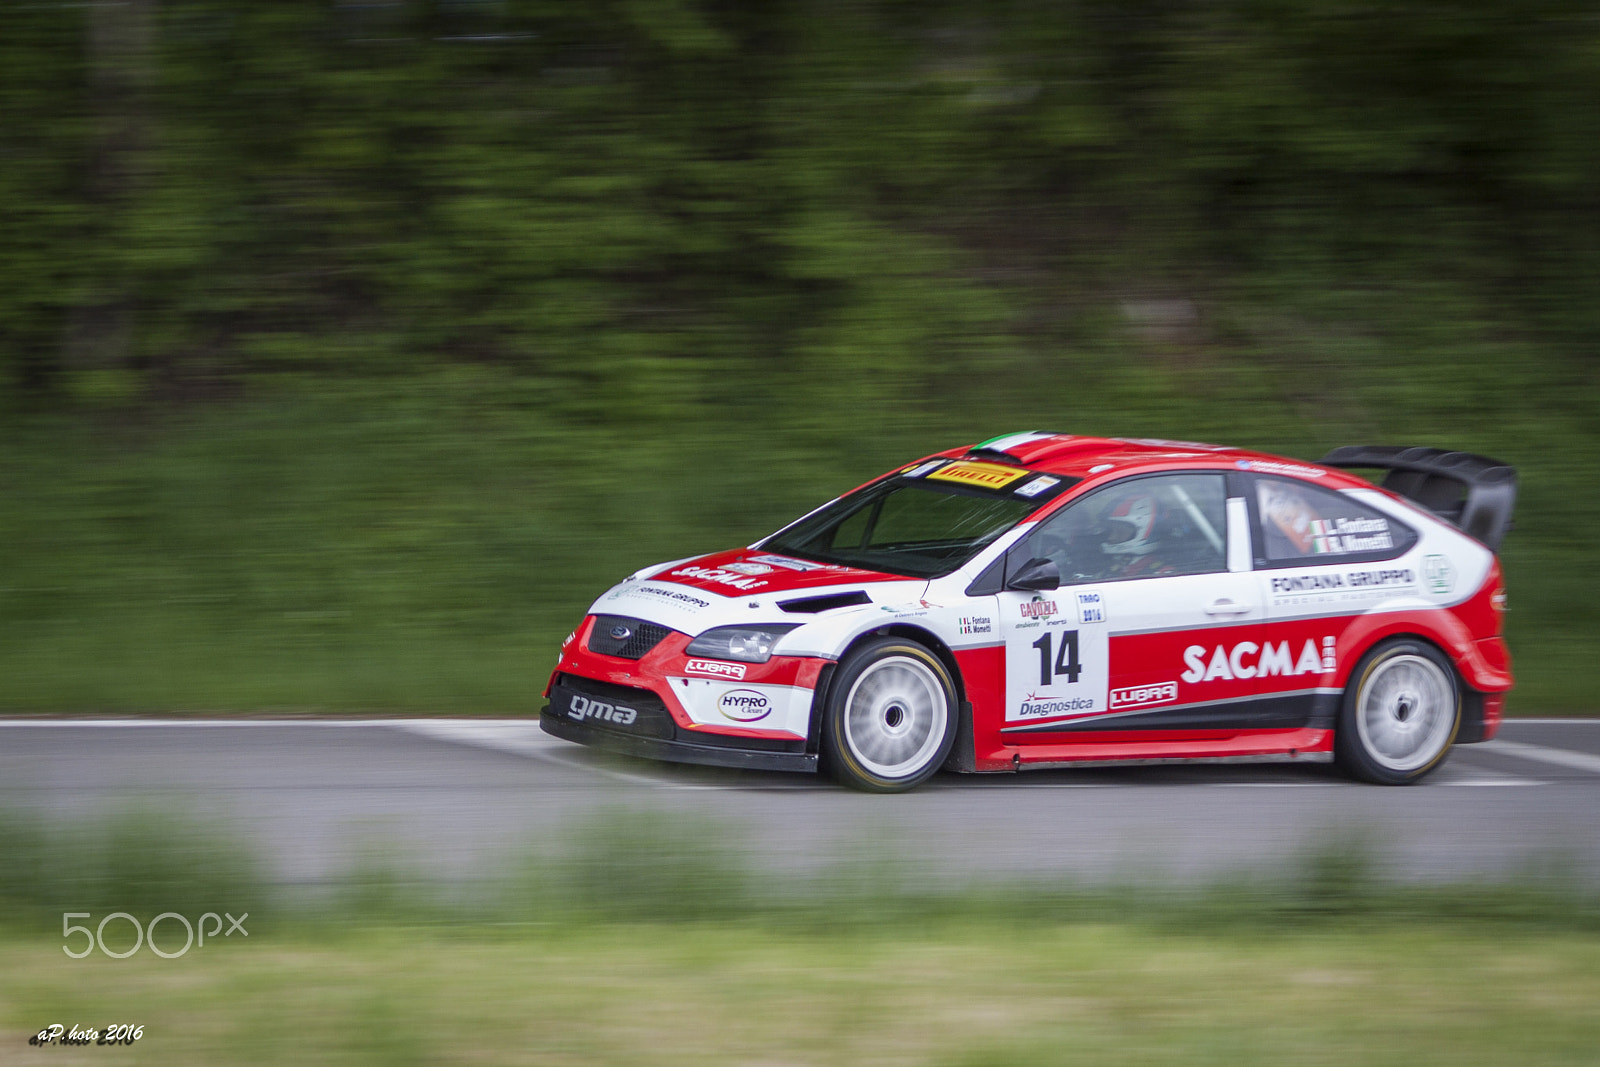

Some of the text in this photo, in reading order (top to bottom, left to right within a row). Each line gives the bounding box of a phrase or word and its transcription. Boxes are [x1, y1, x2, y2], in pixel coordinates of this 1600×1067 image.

[939, 465, 1015, 484] PIRELLI
[1270, 573, 1346, 593] FONTANA
[1347, 568, 1416, 587] GRUPPO
[1032, 629, 1083, 687] 14
[1180, 638, 1324, 684] SACMA
[688, 662, 744, 677] LUBRA
[722, 696, 768, 708] HYPRO
[1111, 685, 1175, 704] LUBRA
[567, 694, 638, 725] gma
[1019, 696, 1094, 716] Diagnostica
